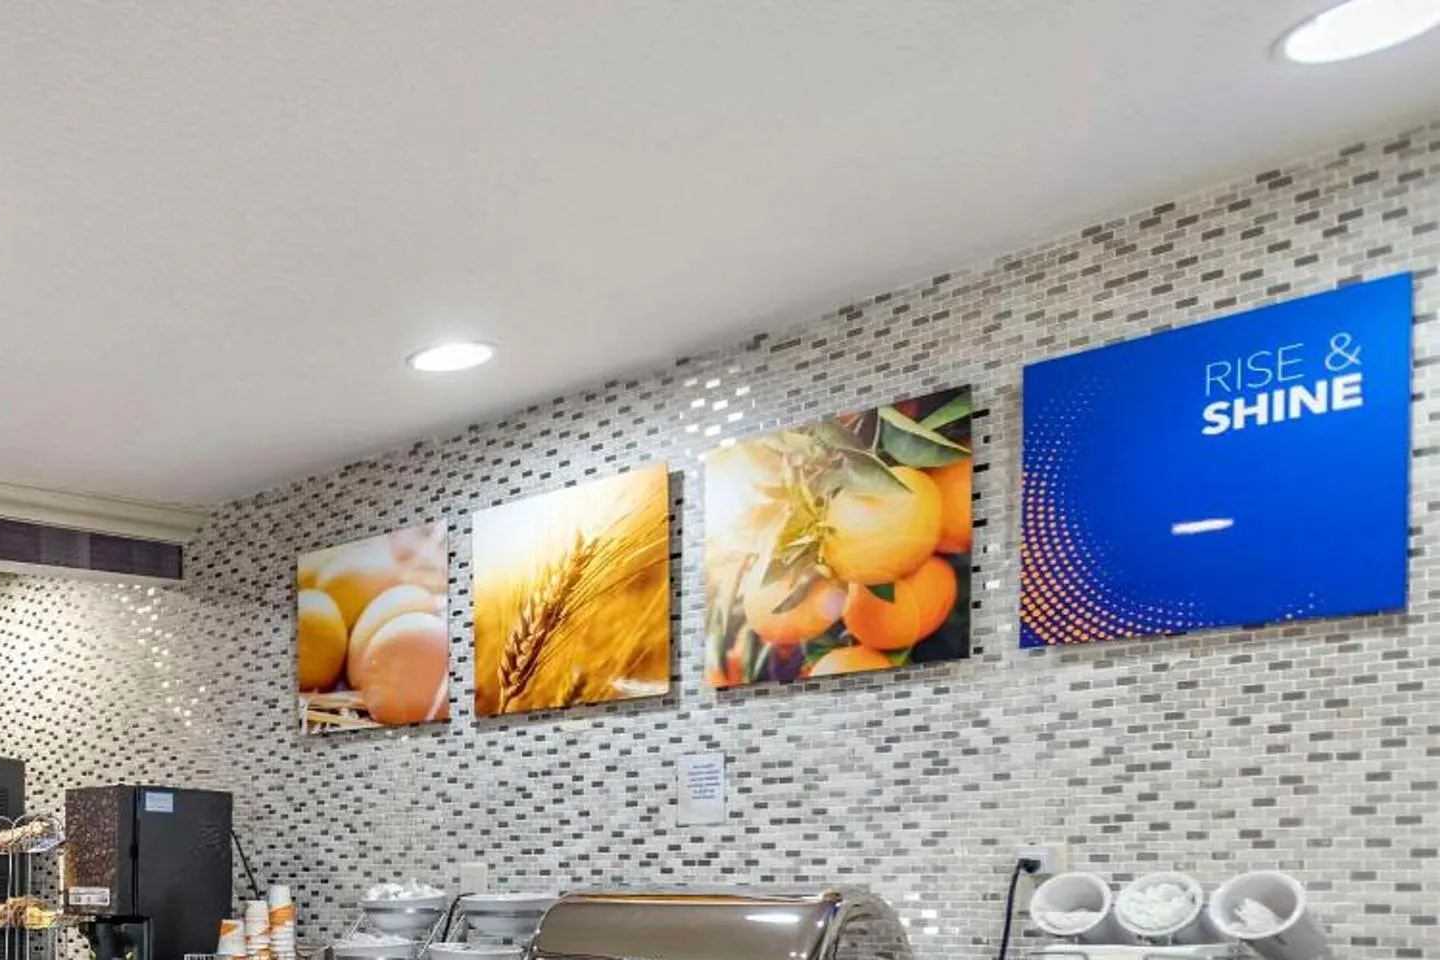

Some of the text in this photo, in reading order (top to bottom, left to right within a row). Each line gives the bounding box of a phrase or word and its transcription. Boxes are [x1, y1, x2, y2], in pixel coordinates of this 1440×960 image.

[1205, 332, 1363, 397] RISE &
[1201, 372, 1364, 436] SHINE
